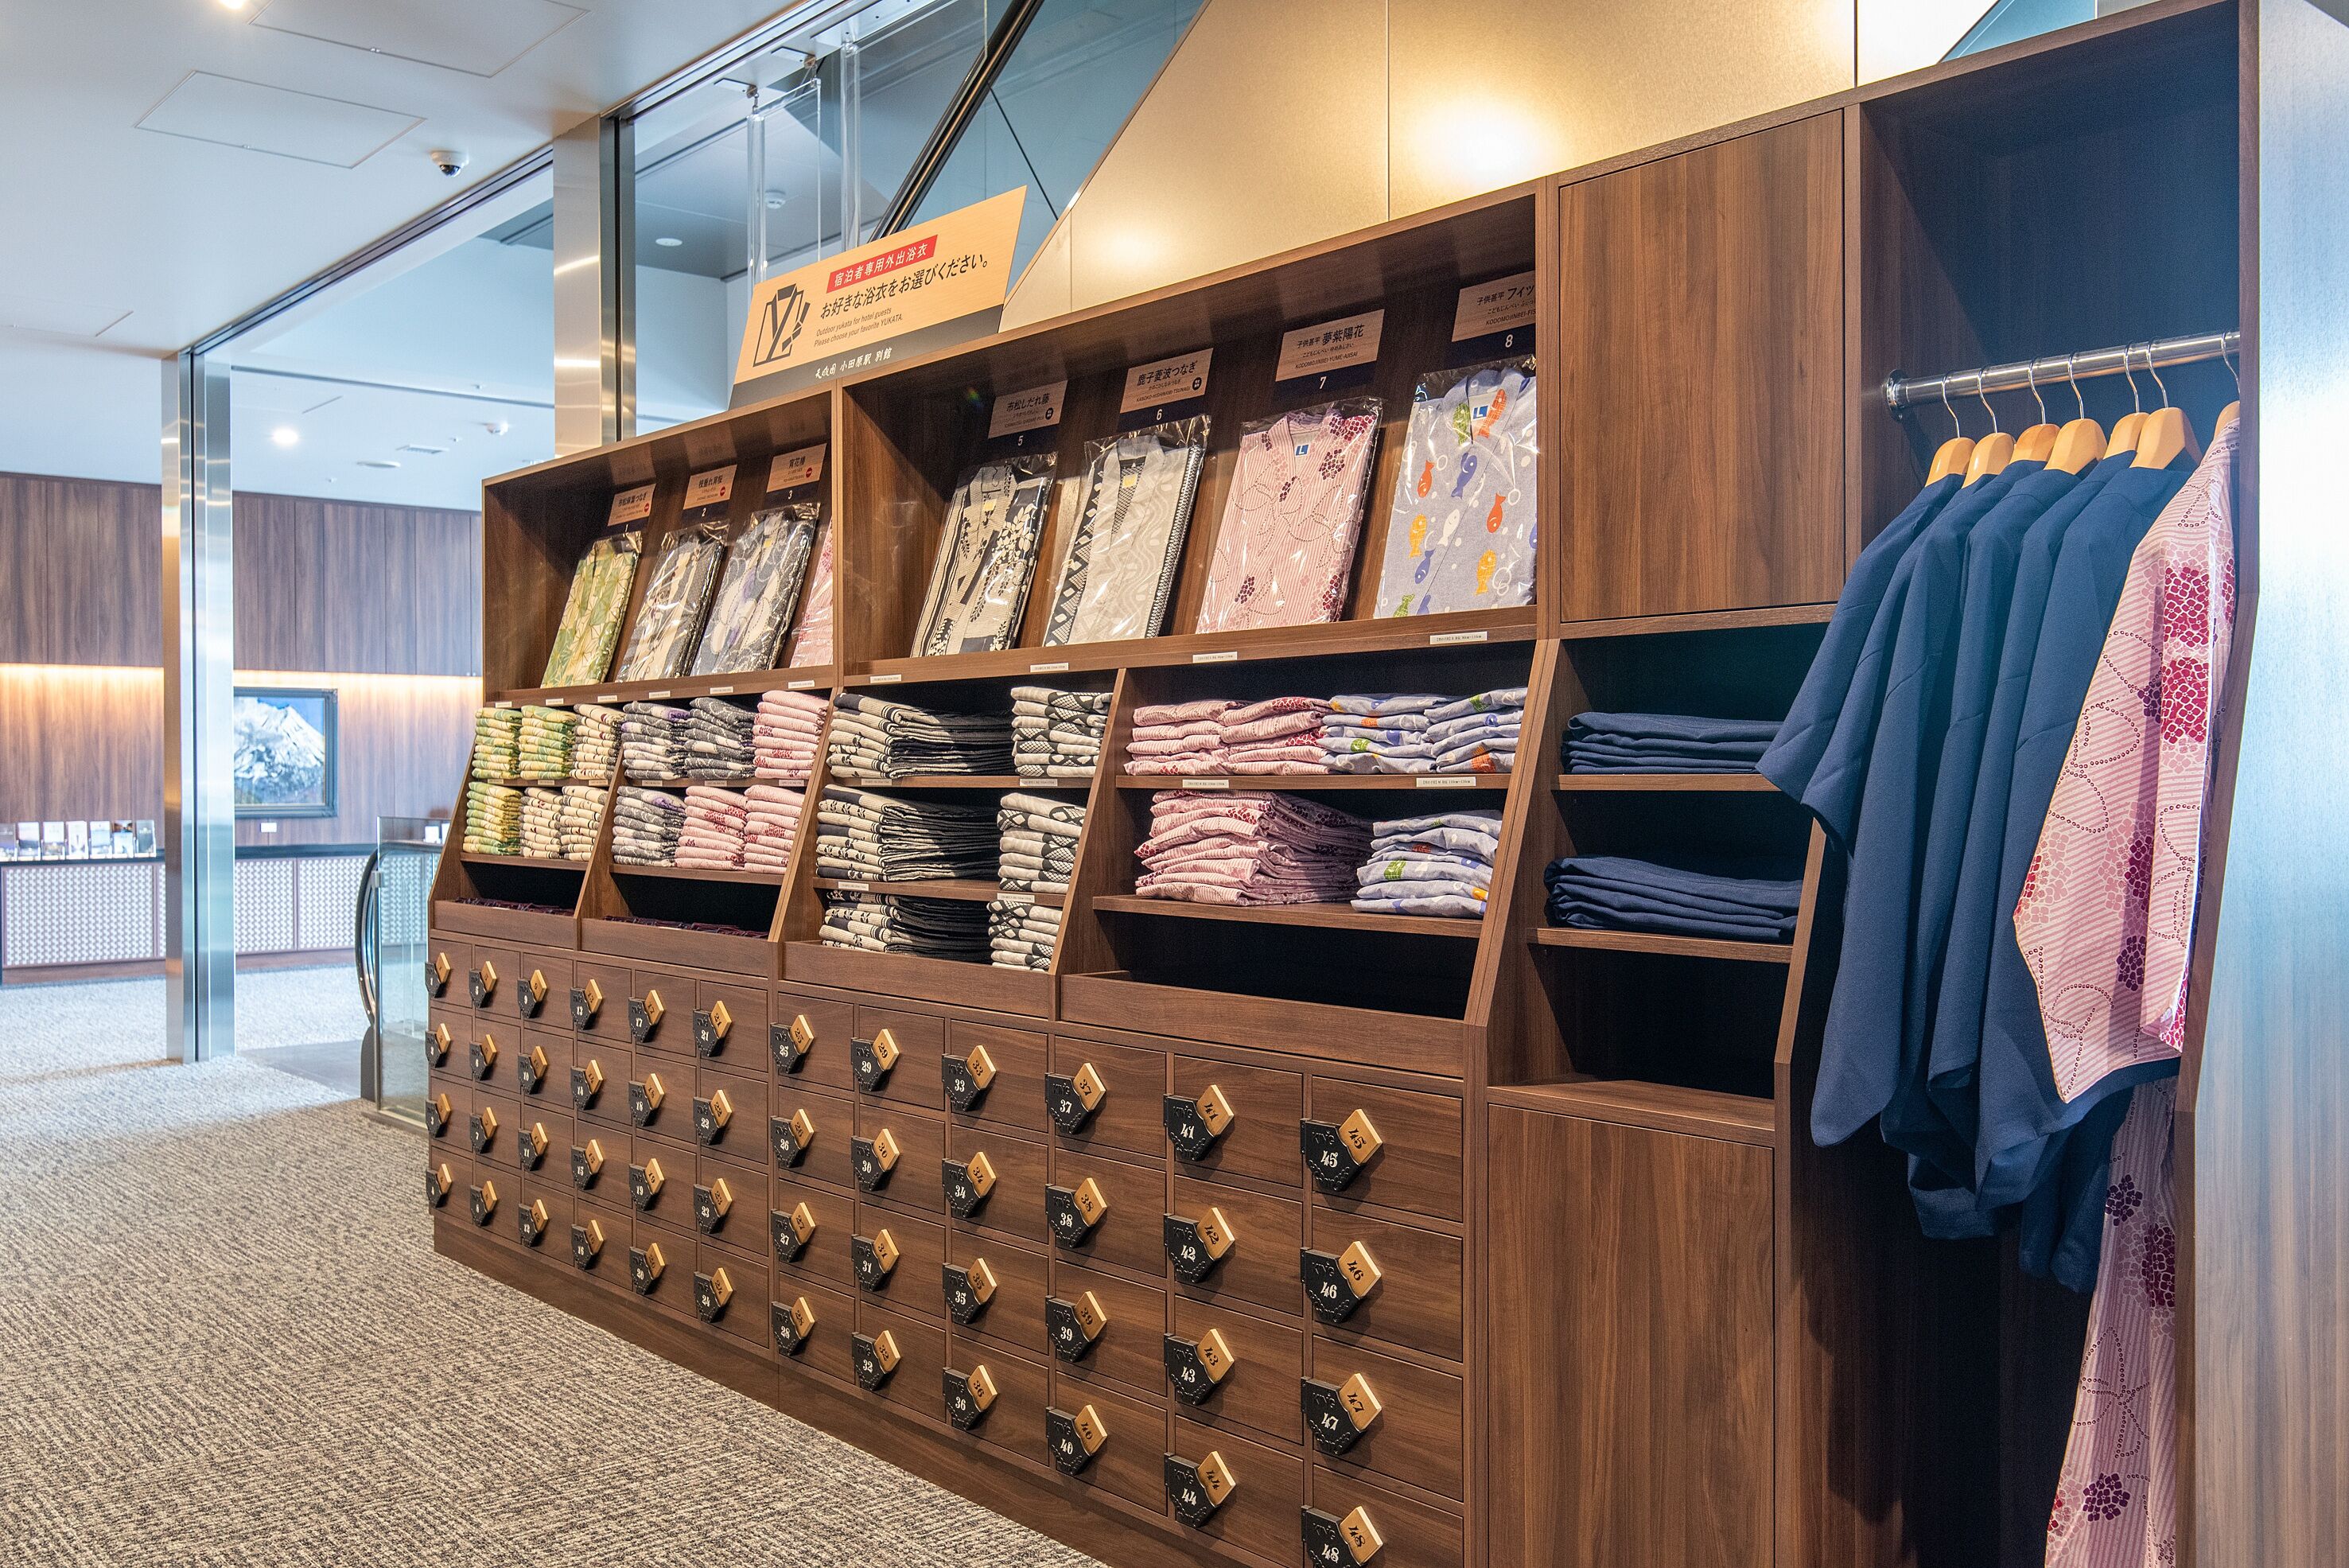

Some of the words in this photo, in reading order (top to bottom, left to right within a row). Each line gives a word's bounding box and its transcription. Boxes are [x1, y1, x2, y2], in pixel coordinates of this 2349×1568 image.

[834, 243, 928, 287] 宿泊者専用外出浴衣
[820, 254, 988, 320] お好きな浴衣をお選びください。
[1476, 291, 1505, 305] 子供甚平
[816, 325, 836, 337] Outdoor
[835, 320, 852, 333] yukata
[861, 312, 875, 323] hotel
[874, 307, 892, 319] guests
[814, 337, 830, 347] Please
[830, 332, 848, 341] choose
[847, 329, 860, 339] your
[860, 321, 879, 333] favorite
[1322, 323, 1365, 345] 夢紫陽花
[1505, 334, 1513, 348] 8
[839, 352, 872, 372] 小田原駅
[875, 347, 892, 362] 別館
[1137, 360, 1198, 387] 鹿子菱波つなぎ
[1319, 375, 1327, 389] 7
[1156, 409, 1163, 421] 6
[1017, 435, 1024, 446] 5
[788, 489, 793, 500] 3
[701, 508, 706, 517] 2
[624, 523, 628, 532] 1
[577, 1006, 583, 1016] 13
[636, 1017, 643, 1027] 17
[701, 1029, 709, 1041] 21
[795, 1028, 803, 1044] 25
[780, 1045, 788, 1057] 25
[878, 1042, 888, 1058] 29
[861, 1060, 871, 1073] 29
[973, 1060, 983, 1076] 33
[955, 1079, 965, 1092] 33
[1080, 1079, 1091, 1095] 37
[714, 1102, 722, 1117] 22
[1060, 1099, 1072, 1114] 37
[1204, 1103, 1218, 1122] 41
[701, 1118, 710, 1130] 22
[1180, 1123, 1194, 1139] 41
[780, 1138, 789, 1150] 26
[1348, 1128, 1366, 1150] 45
[878, 1142, 887, 1158] 30
[862, 1160, 872, 1173] 30
[1320, 1150, 1338, 1168] 45
[578, 1166, 584, 1176] 15
[973, 1167, 983, 1184] 34
[636, 1186, 644, 1196] 19
[955, 1185, 966, 1199] 34
[1081, 1194, 1093, 1212] 38
[702, 1206, 710, 1218] 23
[1060, 1212, 1072, 1228] 38
[780, 1233, 789, 1245] 27
[1204, 1225, 1219, 1245] 42
[578, 1246, 584, 1255] 16
[878, 1243, 888, 1259] 31
[1180, 1245, 1196, 1263] 42
[636, 1268, 644, 1280] 20
[862, 1260, 872, 1274] 31
[1347, 1260, 1363, 1281] 46
[973, 1273, 984, 1290] 35
[955, 1290, 966, 1305] 35
[1320, 1282, 1337, 1298] 46
[702, 1294, 710, 1307] 24
[1080, 1307, 1093, 1325] 39
[780, 1326, 790, 1339] 28
[1060, 1326, 1072, 1341] 39
[879, 1344, 889, 1361] 32
[1204, 1347, 1218, 1366] 43
[863, 1360, 873, 1373] 32
[1181, 1366, 1195, 1383] 43
[974, 1380, 984, 1397] 36
[955, 1396, 966, 1410] 36
[1347, 1392, 1364, 1412] 47
[1321, 1412, 1339, 1430] 47
[1080, 1422, 1092, 1440] 40
[1060, 1438, 1073, 1454] 40
[1206, 1470, 1219, 1489] 44
[1181, 1488, 1196, 1506] 44
[1348, 1526, 1365, 1547] 48
[1321, 1543, 1339, 1563] 48
